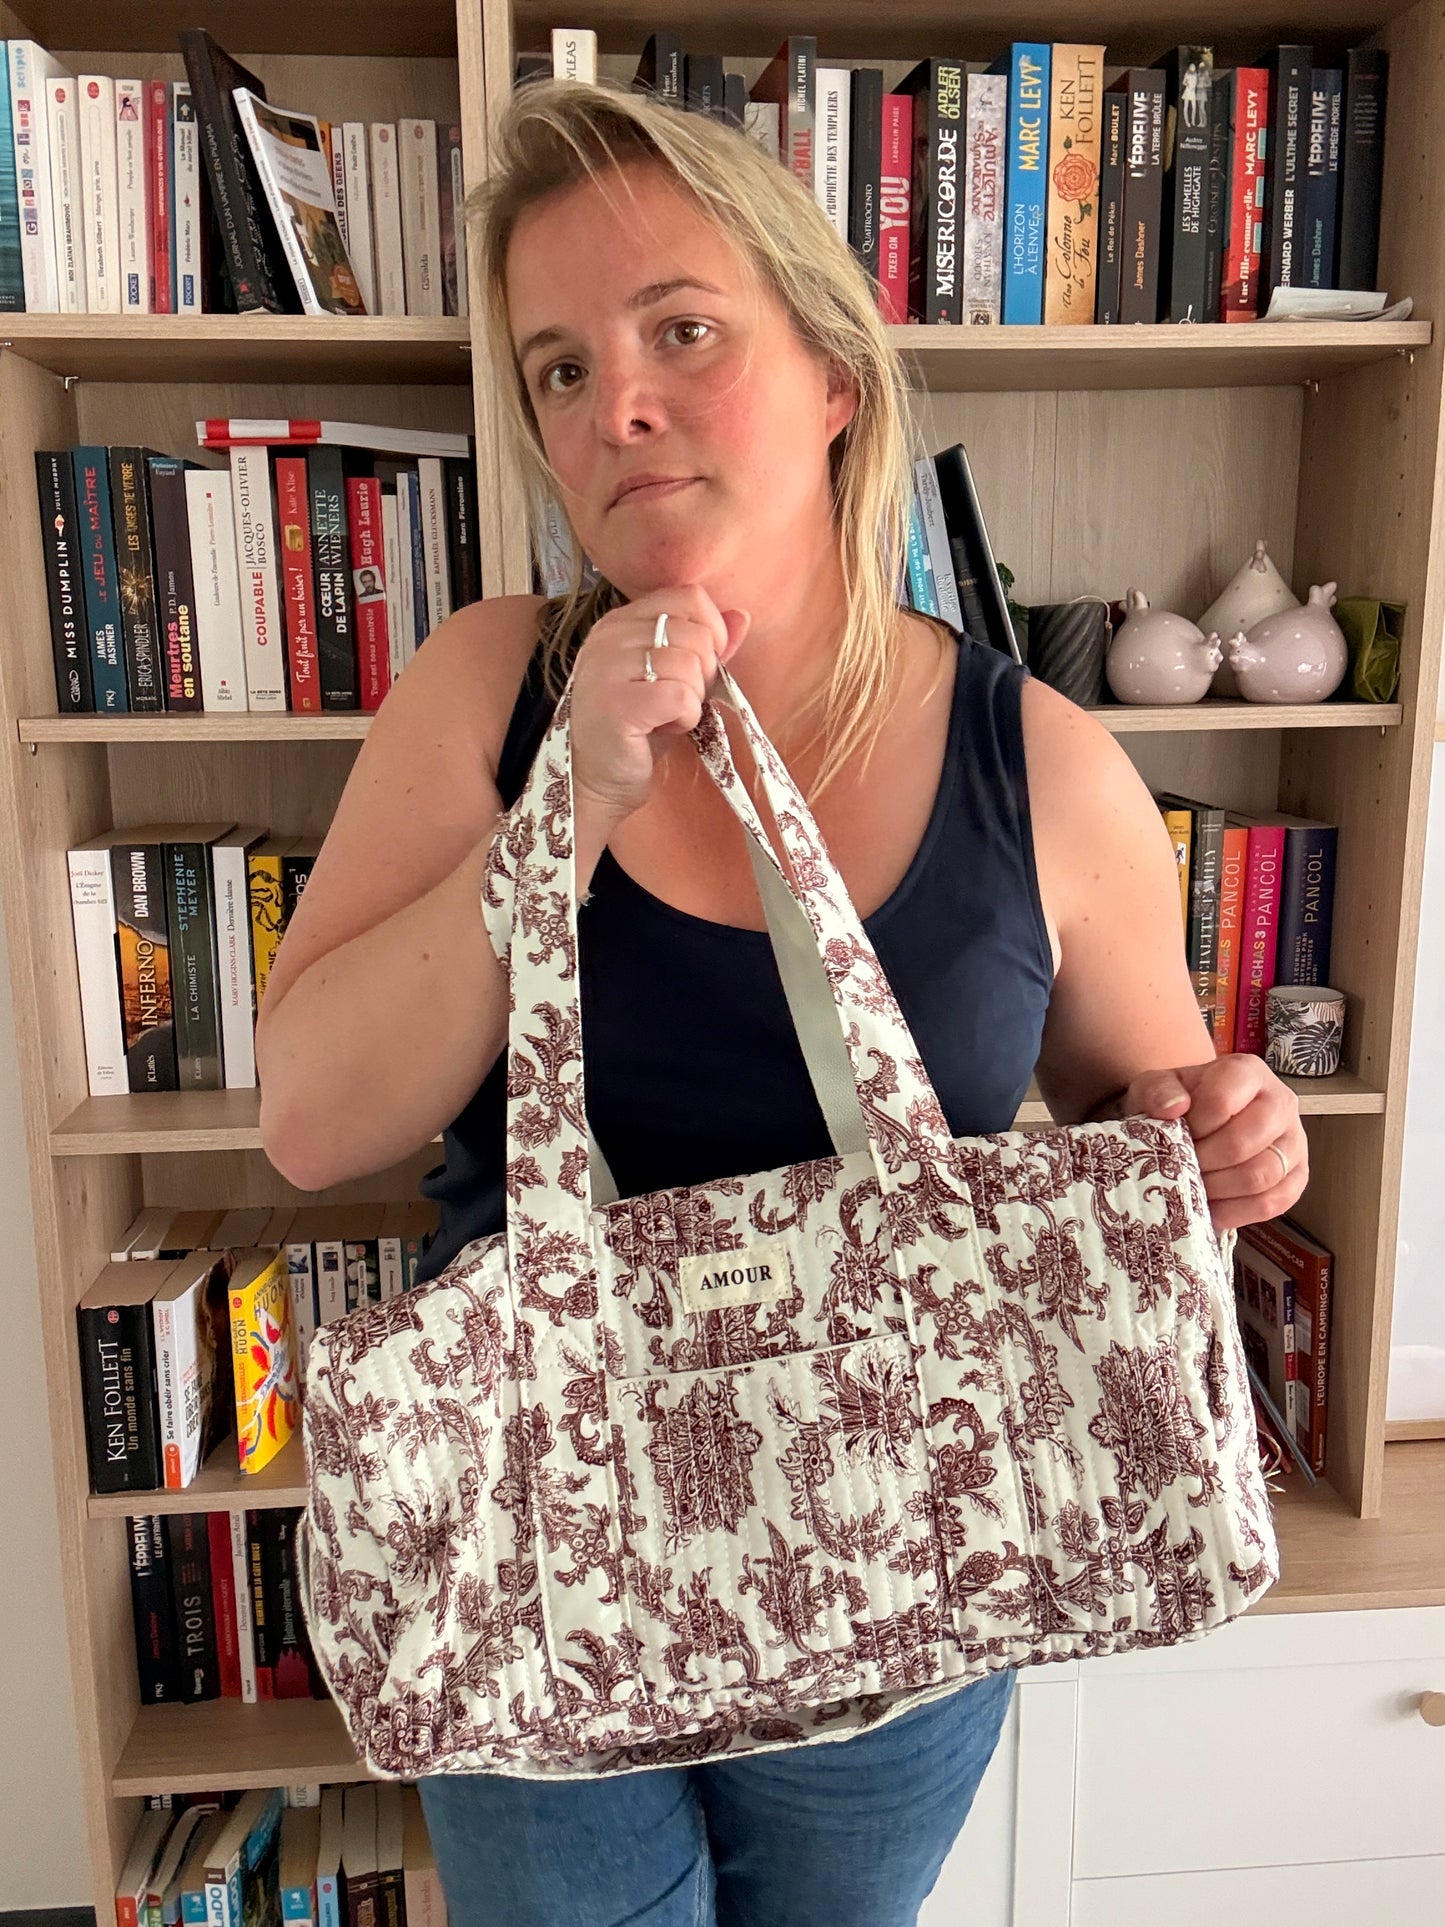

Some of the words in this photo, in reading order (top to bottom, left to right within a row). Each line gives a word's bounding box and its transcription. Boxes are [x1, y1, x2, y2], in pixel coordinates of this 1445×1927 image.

[798, 55, 806, 82] PLATINI
[1020, 61, 1042, 109] LEVY
[798, 85, 806, 112] MICHEL
[939, 66, 948, 114] ADLER
[949, 67, 961, 119] OLSEN
[1060, 79, 1075, 120] KEN
[1076, 54, 1095, 144] FOLLETT
[1288, 86, 1299, 127] SECRET
[828, 91, 838, 141] TEMPLIERS
[1112, 104, 1120, 142] BOULET
[1152, 94, 1162, 125] BRÛLÉE
[1247, 89, 1258, 127] LEVY
[1332, 92, 1341, 125] MORTEL
[206, 123, 219, 157] PYJAMA
[1019, 117, 1040, 171] MARC
[1128, 92, 1150, 177] L'ÉPREUVE
[1153, 126, 1161, 152] TERRE
[1309, 91, 1328, 176] L'ÉPREUVE
[1330, 127, 1339, 159] REMÈDE
[212, 158, 222, 170] EN
[827, 145, 837, 162] DES
[1111, 143, 1119, 165] Marc
[1152, 154, 1160, 165] LA
[1246, 132, 1256, 175] MARC
[1286, 130, 1297, 182] L'ULTIME
[1330, 161, 1338, 171] LE
[216, 172, 229, 206] VAMPIRE
[824, 165, 837, 216] PROPHÉTIE
[880, 175, 910, 230] YOU
[1183, 166, 1193, 214] JUMELLES
[1192, 165, 1202, 218] HIGHGATE
[1244, 188, 1253, 210] elle
[1108, 202, 1116, 226] Pékin
[1183, 216, 1191, 232] LES
[1192, 220, 1200, 233] DE
[1284, 189, 1294, 238] WERBER
[231, 230, 244, 269] JOURNAL
[890, 236, 898, 250] ON
[1014, 204, 1025, 275] L'HORIZON
[1055, 216, 1072, 279] Colonne
[1109, 228, 1115, 238] de
[1136, 221, 1146, 258] Dashner
[1244, 212, 1252, 253] comme
[1312, 218, 1323, 255] Dashner
[889, 252, 898, 279] FIXED
[1027, 265, 1037, 275] À
[1108, 253, 1114, 263] Le
[1134, 260, 1144, 290] James
[1240, 254, 1250, 279] fille
[1311, 258, 1321, 286] James
[130, 274, 139, 304] POCKET
[185, 275, 193, 304] POCKET
[51, 457, 60, 488] MURPHY
[122, 462, 135, 491] VERRE
[84, 467, 100, 530] MAÎTRE
[238, 456, 256, 565] JACQUES-OLIVIER
[289, 495, 298, 514] Kate
[359, 483, 370, 526] Laurie
[430, 488, 439, 540] GLUCKSMANN
[129, 534, 140, 551] LES
[256, 523, 267, 564] BOSCO
[315, 489, 330, 565] ANNETTE
[328, 494, 342, 564] WIENERS
[361, 530, 374, 565] Hugh
[430, 542, 441, 574] RAPHAËL
[57, 541, 74, 615] DUMPLIN
[94, 553, 106, 586] JEU
[167, 571, 176, 595] James
[294, 575, 305, 601] baiser
[321, 573, 332, 617] CŒUR
[335, 573, 345, 613] LAPIN
[253, 572, 267, 646] COUPABLE
[298, 602, 306, 616] un
[298, 618, 313, 634] par
[337, 615, 347, 633] DE
[367, 608, 376, 644] contrôle
[64, 621, 78, 658] MISS
[96, 630, 106, 659] JAMES
[106, 624, 118, 665] DASHNER
[134, 623, 150, 662] SPINDLER
[178, 605, 194, 672] soutane
[297, 636, 315, 658] finit
[369, 645, 377, 662] sous
[137, 664, 153, 687] ERICA
[167, 622, 182, 699] Meurtres
[297, 660, 312, 682] Tout
[184, 677, 194, 698] en
[371, 677, 379, 696] Tout
[131, 852, 147, 892] BROWN
[1202, 848, 1216, 903] FAMILY
[1222, 850, 1241, 929] PANCOL
[1258, 848, 1277, 926] PANCOL
[1304, 848, 1323, 923] PANCOL
[133, 894, 149, 918] DAN
[175, 854, 188, 931] STEPHENIE
[188, 869, 198, 916] MEYER
[227, 901, 235, 931] Dernière
[1198, 913, 1214, 996] SOCIALITE
[137, 940, 158, 1026] INFERNO
[188, 955, 198, 1002] CHIMISTE
[1247, 941, 1265, 1028] MUCHACHAS
[1256, 930, 1266, 939] 3
[190, 1006, 200, 1020] LA
[700, 1265, 772, 1290] AMOUR
[1319, 1268, 1329, 1339] CAMPING-CAR
[239, 1319, 248, 1354] HUON
[1318, 1342, 1326, 1355] EN
[121, 1348, 132, 1362] fin
[98, 1339, 122, 1416] FOLLETT
[125, 1366, 134, 1391] sans
[1317, 1358, 1326, 1406] L'EUROPE
[125, 1396, 137, 1431] monde
[107, 1423, 127, 1462] KEN
[128, 1436, 139, 1450] Un
[167, 1430, 174, 1440] Se
[156, 1550, 163, 1558] LE
[184, 1596, 204, 1656] TROIS
